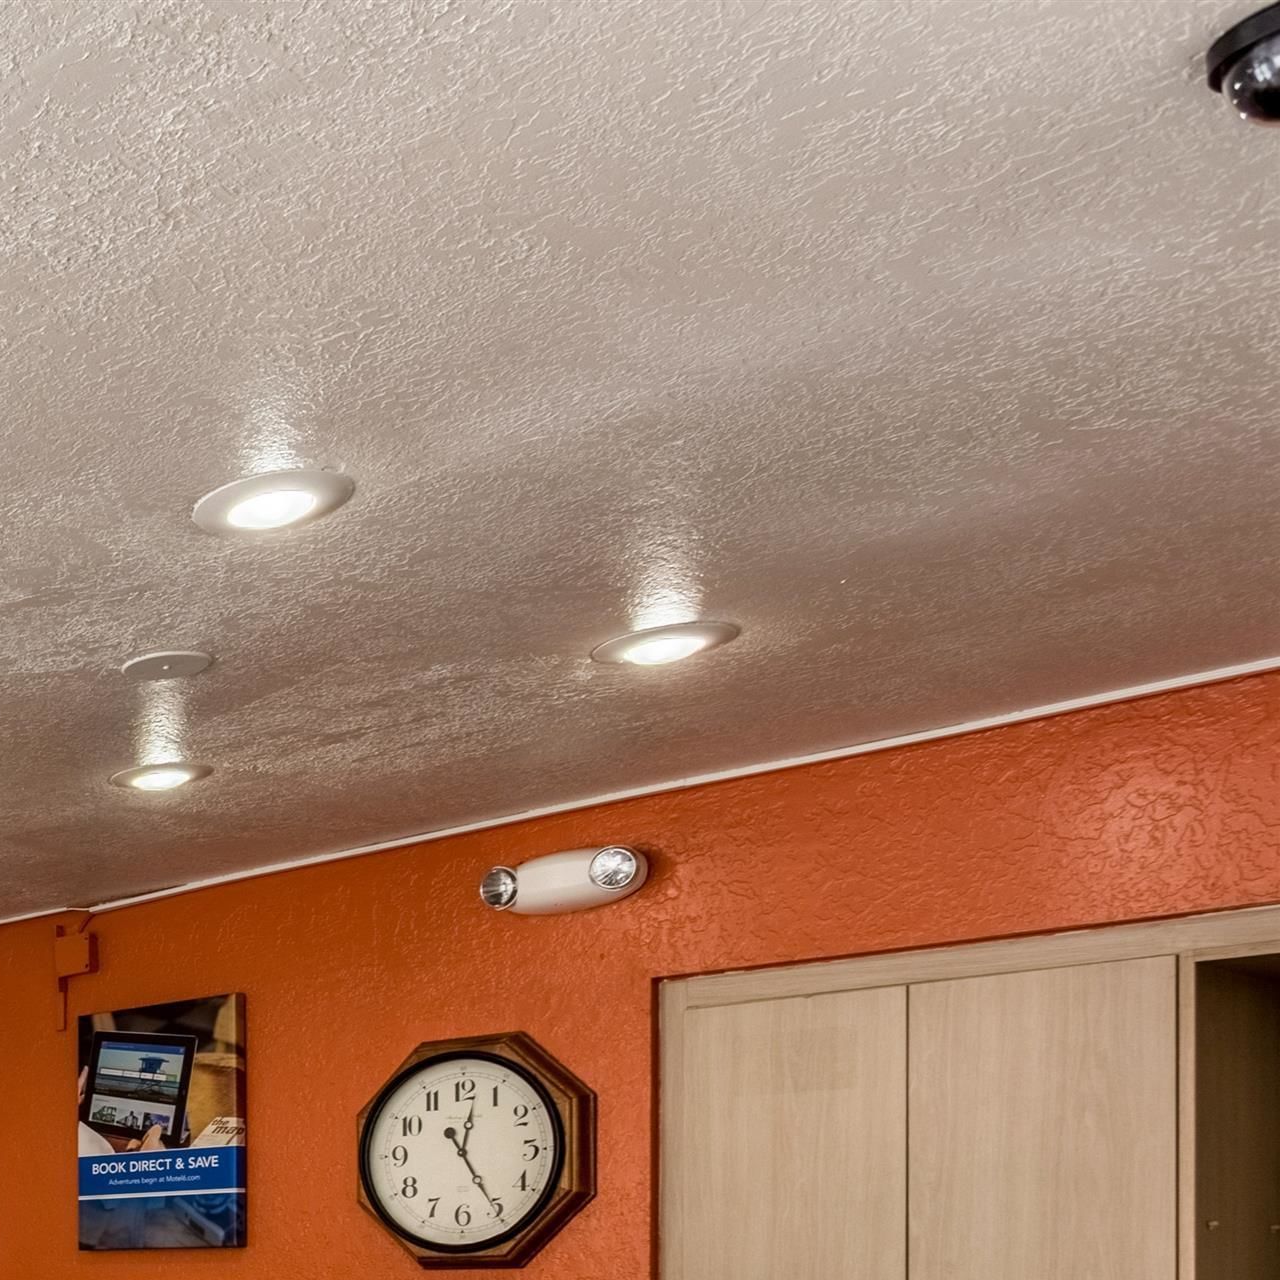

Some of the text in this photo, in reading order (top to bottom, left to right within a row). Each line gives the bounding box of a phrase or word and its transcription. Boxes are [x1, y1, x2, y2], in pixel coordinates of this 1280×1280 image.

[426, 1089, 439, 1111] 11
[454, 1079, 476, 1102] 12
[492, 1085, 498, 1107] 1
[402, 1115, 422, 1136] 10
[513, 1104, 529, 1127] 2
[213, 1125, 245, 1145] map
[392, 1145, 408, 1167] 9
[522, 1138, 540, 1161] 3
[92, 1155, 219, 1175] BOOK DIRECT & SAVE
[108, 1176, 140, 1186] Adventures
[141, 1175, 158, 1186] begin
[166, 1174, 201, 1182] Motel6.com
[401, 1176, 418, 1198] 8
[512, 1169, 529, 1191] 4
[428, 1197, 440, 1218] 7
[454, 1203, 471, 1226] 6
[486, 1197, 504, 1218] 5
